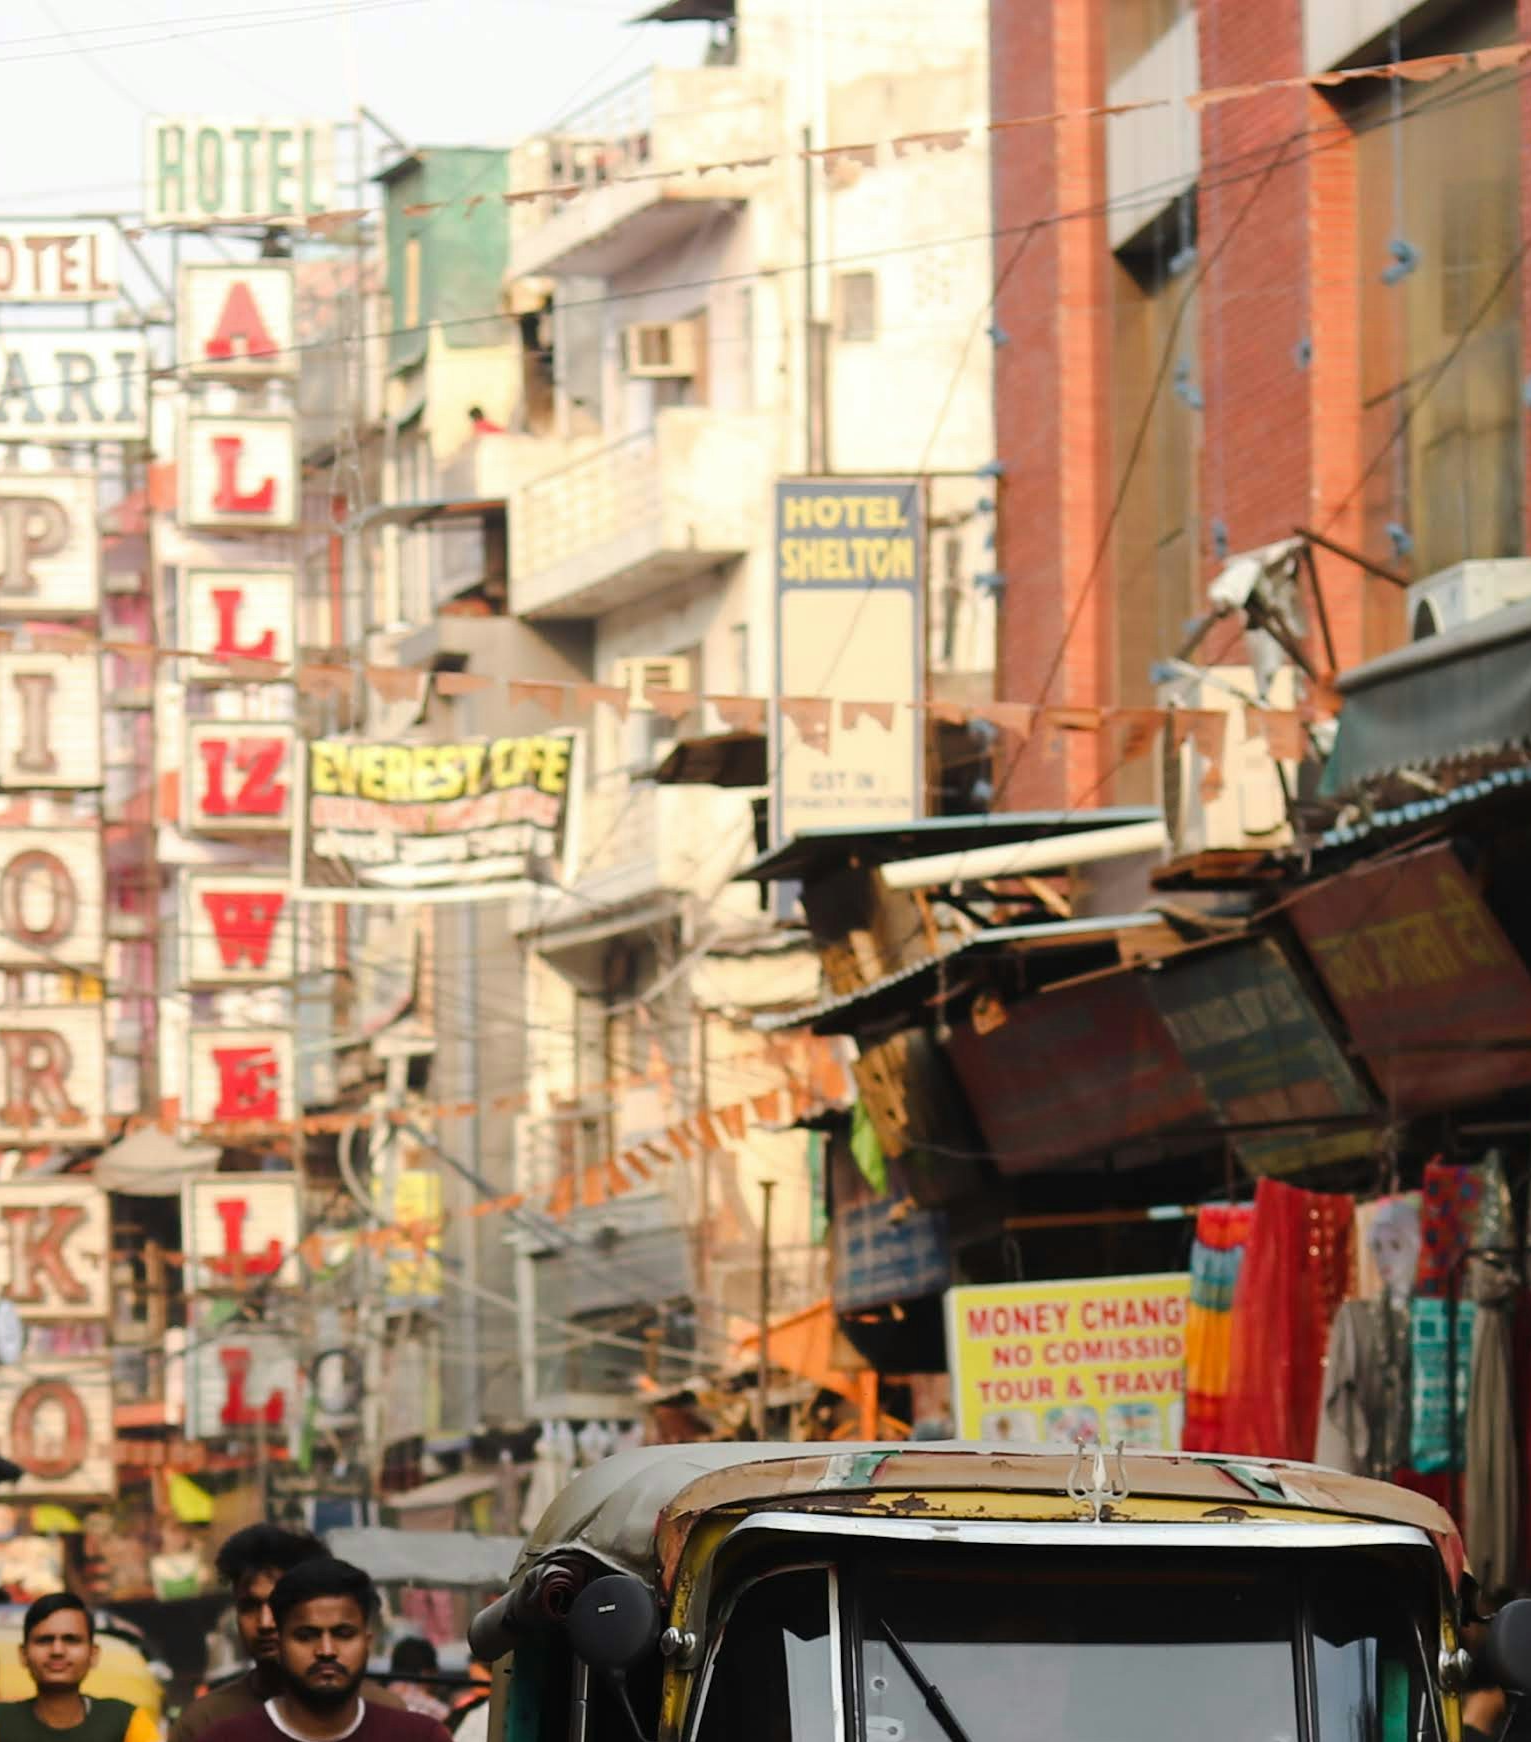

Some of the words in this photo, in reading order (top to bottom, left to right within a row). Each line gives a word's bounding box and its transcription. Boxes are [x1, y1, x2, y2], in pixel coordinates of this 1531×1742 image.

[155, 126, 328, 213] HOTEL
[783, 495, 910, 530] HOTEL
[779, 535, 916, 583] SHELTON
[309, 738, 487, 804] EVEREST
[967, 1302, 1070, 1338] MONEY
[993, 1344, 1033, 1367] NO
[1042, 1334, 1183, 1365] COMISSIO
[978, 1375, 1053, 1403] TOUR
[1066, 1373, 1084, 1397] &
